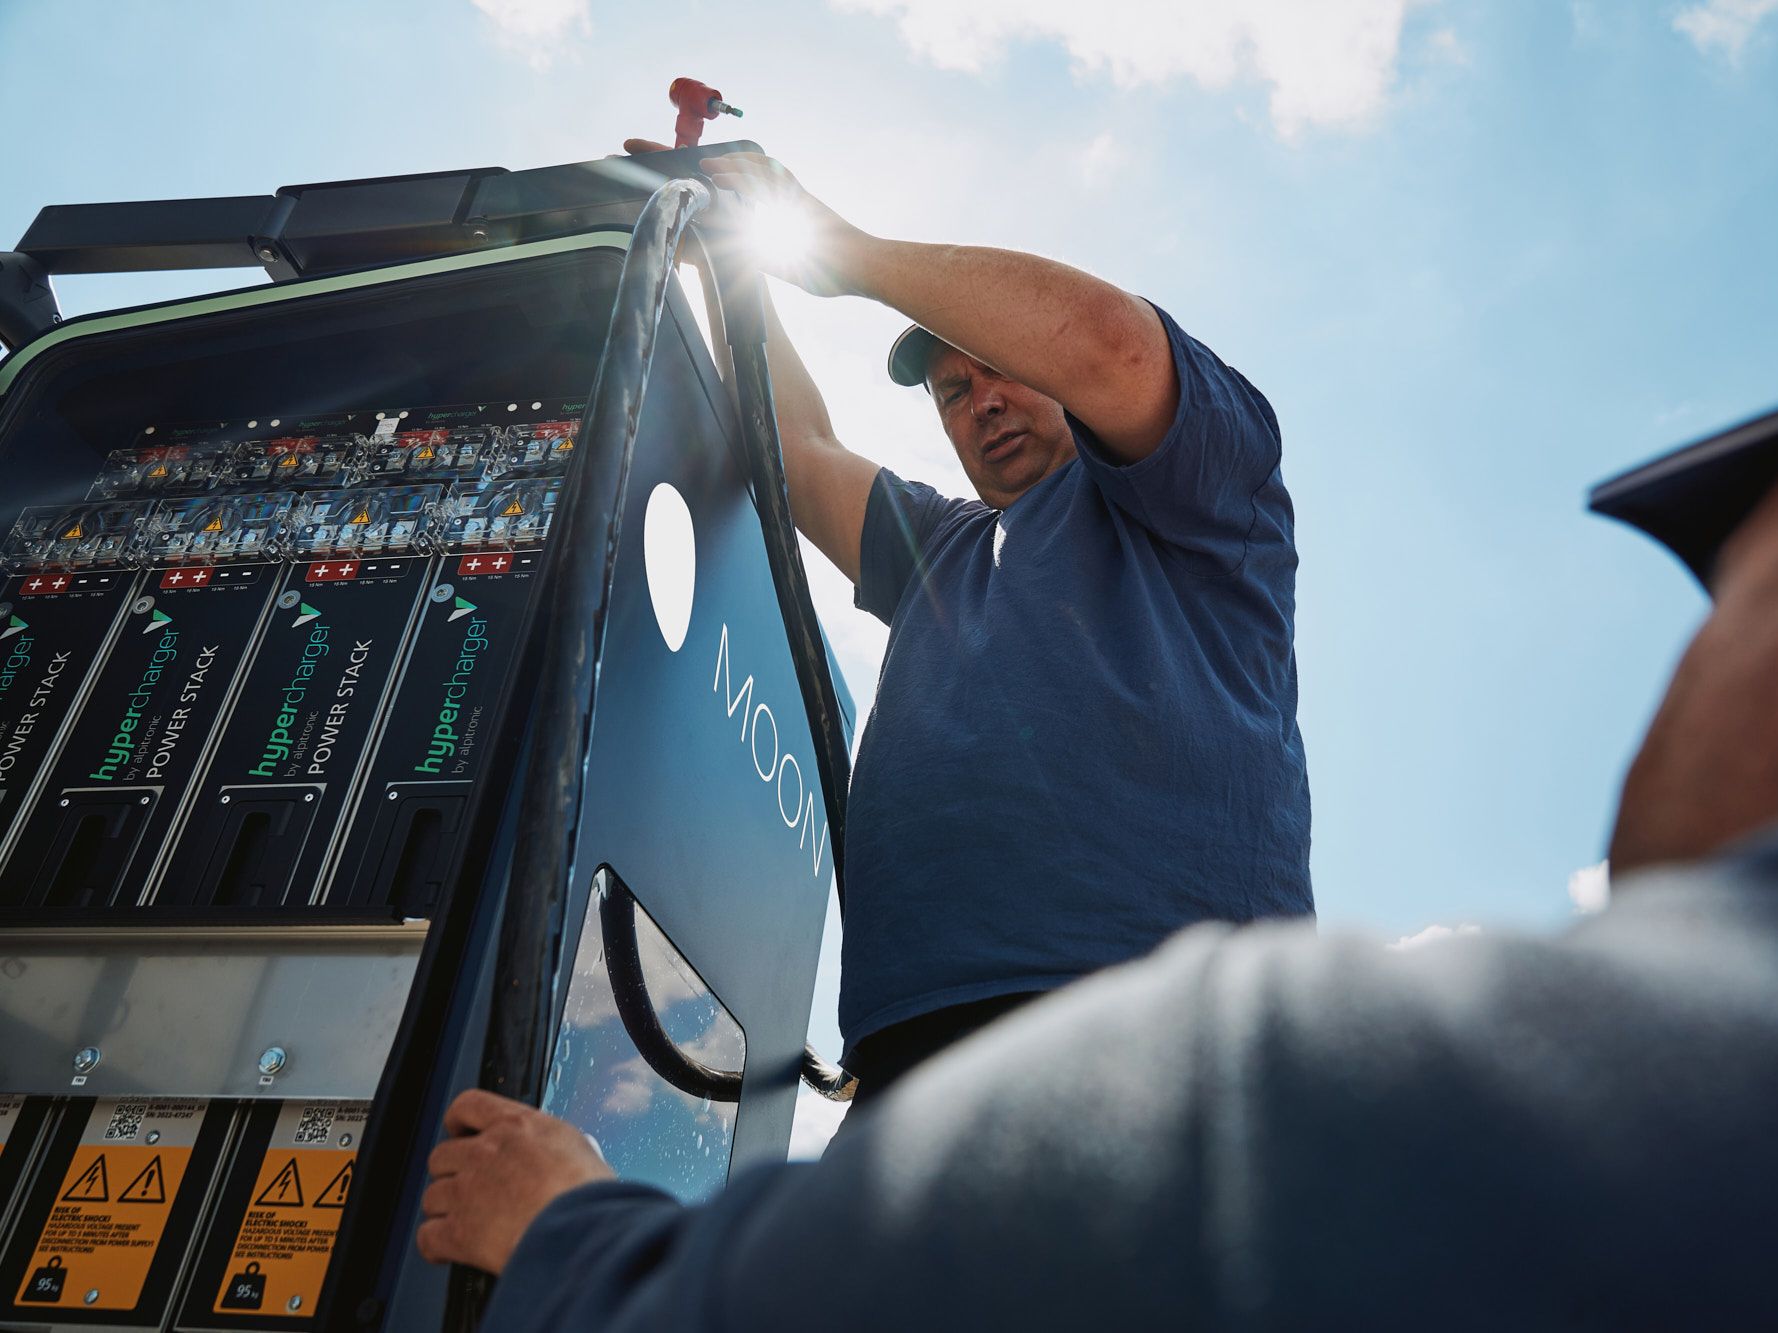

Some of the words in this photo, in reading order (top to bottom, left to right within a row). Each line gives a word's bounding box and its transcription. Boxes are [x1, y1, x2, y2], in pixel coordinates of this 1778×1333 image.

[0, 634, 34, 695] arger
[30, 650, 72, 708] STACK
[414, 616, 489, 774] hypercharger
[88, 628, 180, 780] hypercharger
[146, 707, 192, 778] POWER
[180, 644, 219, 702] STACK
[248, 622, 333, 776] hypercharger
[307, 702, 350, 774] POWER
[336, 639, 372, 698] STACK
[459, 705, 483, 756] alpitronic
[123, 766, 140, 782] by
[133, 715, 162, 764] alpitronic
[284, 763, 301, 777] by
[294, 710, 319, 760] alpitronic
[451, 760, 469, 774] by
[714, 622, 828, 878] MOON
[36, 1278, 54, 1291] 95
[236, 1284, 252, 1298] 95
